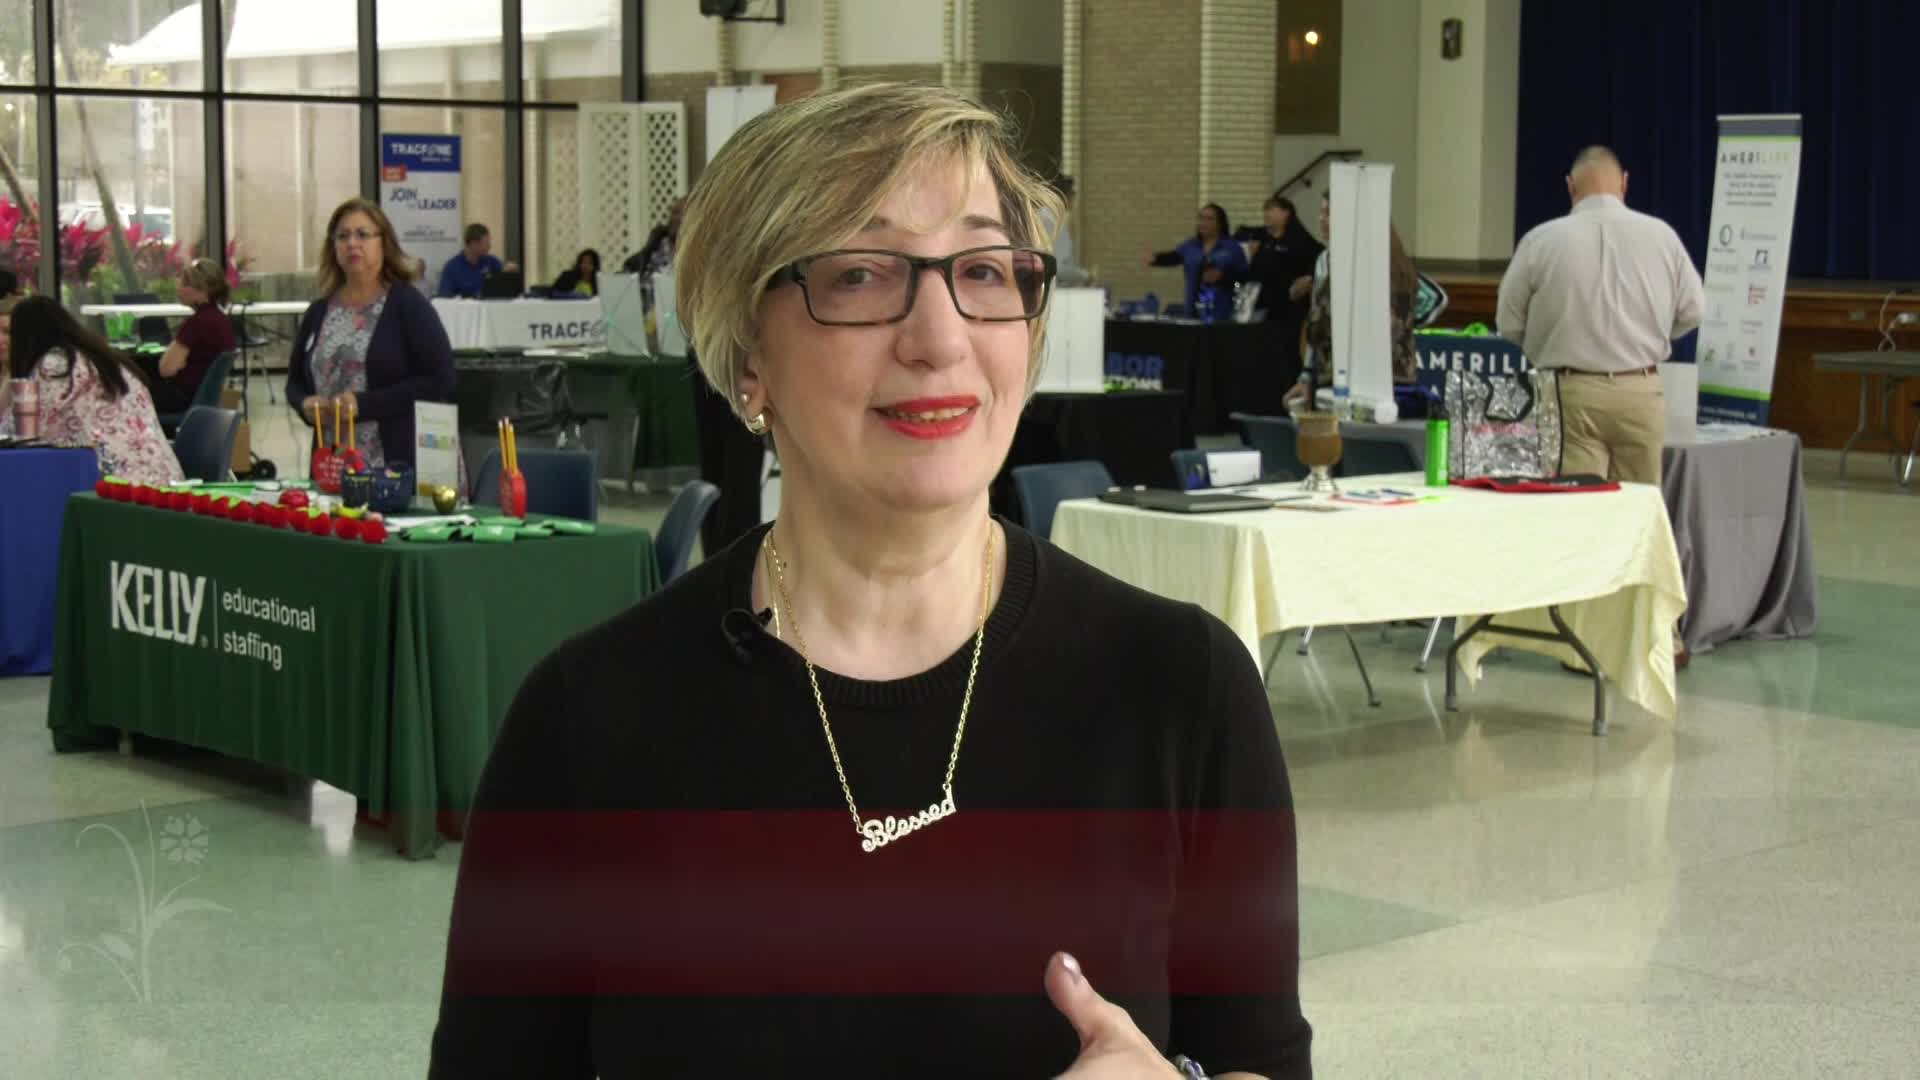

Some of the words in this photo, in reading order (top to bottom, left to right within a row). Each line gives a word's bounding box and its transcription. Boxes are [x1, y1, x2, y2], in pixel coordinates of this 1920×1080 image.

[390, 187, 418, 202] JOIN
[418, 198, 458, 210] LEADER
[1414, 350, 1528, 374] AMERILI
[110, 560, 207, 646] KELLY
[222, 587, 316, 633] educational
[223, 631, 284, 671] staffing
[861, 783, 957, 853] Blessed
